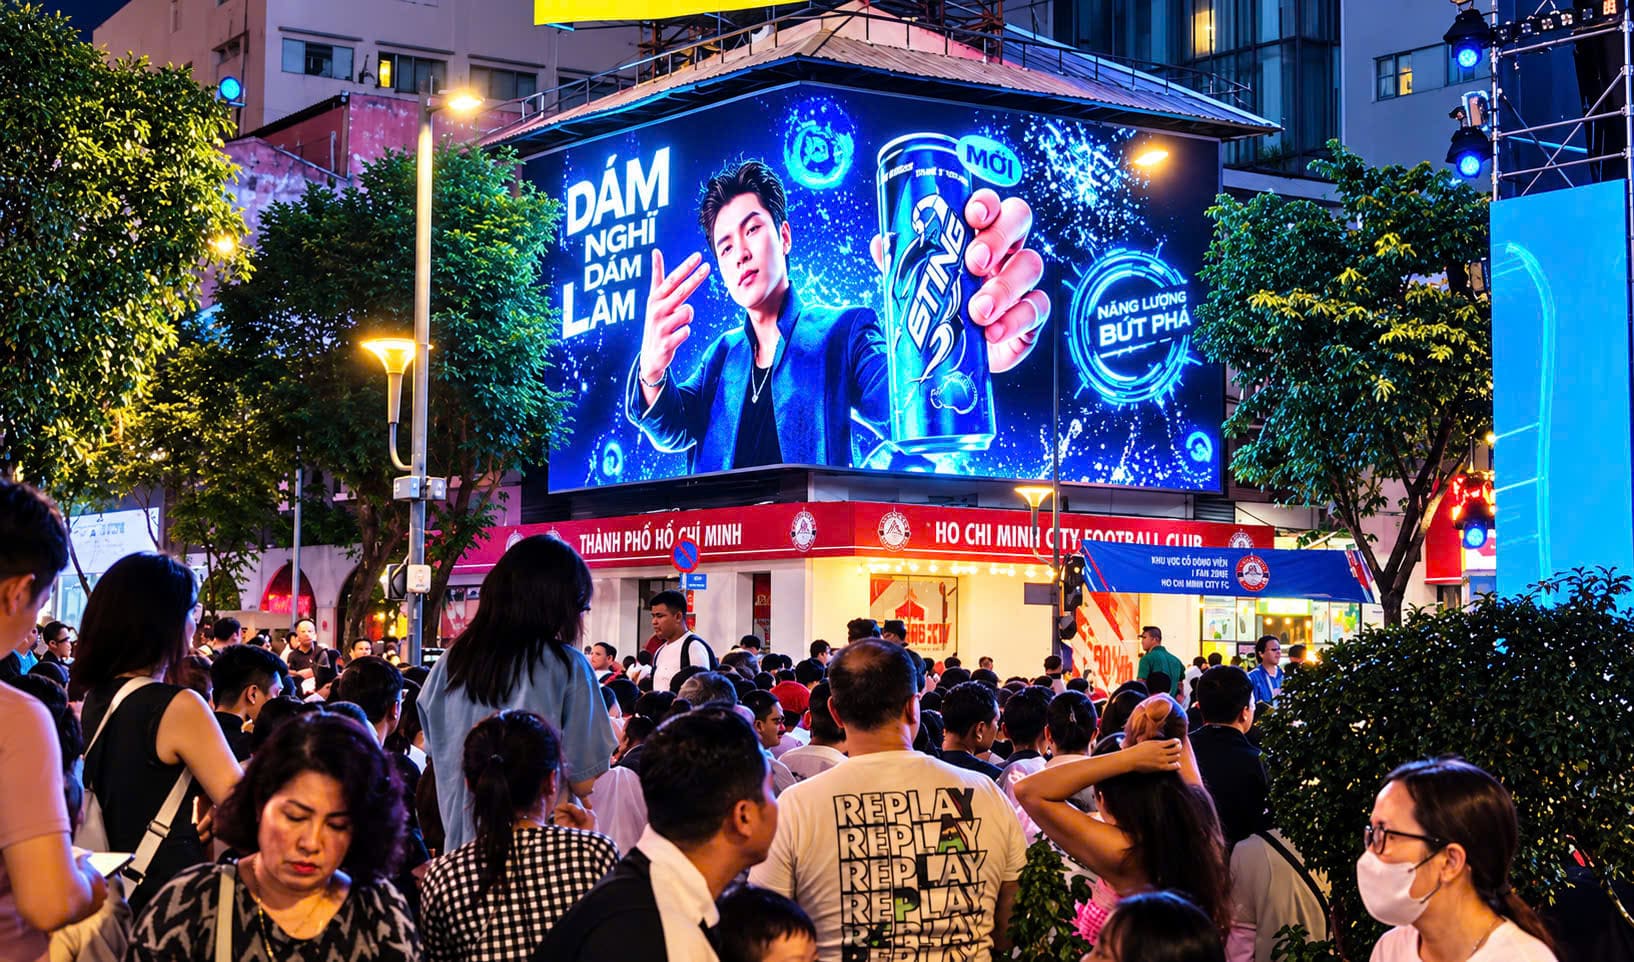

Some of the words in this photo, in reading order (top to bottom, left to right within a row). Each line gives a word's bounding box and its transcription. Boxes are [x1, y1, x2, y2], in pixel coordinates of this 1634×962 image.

[567, 146, 670, 236] DÁM
[584, 254, 642, 292] DÁM
[907, 210, 965, 351] STING
[562, 281, 636, 339] LÀM
[1097, 298, 1140, 320] NĂNG
[1142, 291, 1187, 310] LƯỢNG
[1152, 304, 1192, 334] PHÁ
[579, 527, 620, 554] THÀNH
[624, 521, 652, 552] PHỐ
[704, 520, 742, 547] MINH
[935, 521, 960, 544] HO
[964, 523, 991, 546] CHI
[996, 524, 1040, 549] MINH
[1045, 527, 1080, 550] CTY
[1195, 569, 1210, 578] FAN
[1221, 580, 1230, 590] FC
[833, 787, 975, 828] REPLAY
[838, 818, 982, 860] REPLAY
[840, 850, 988, 892] REPLAY
[841, 881, 986, 924] REPLAY
